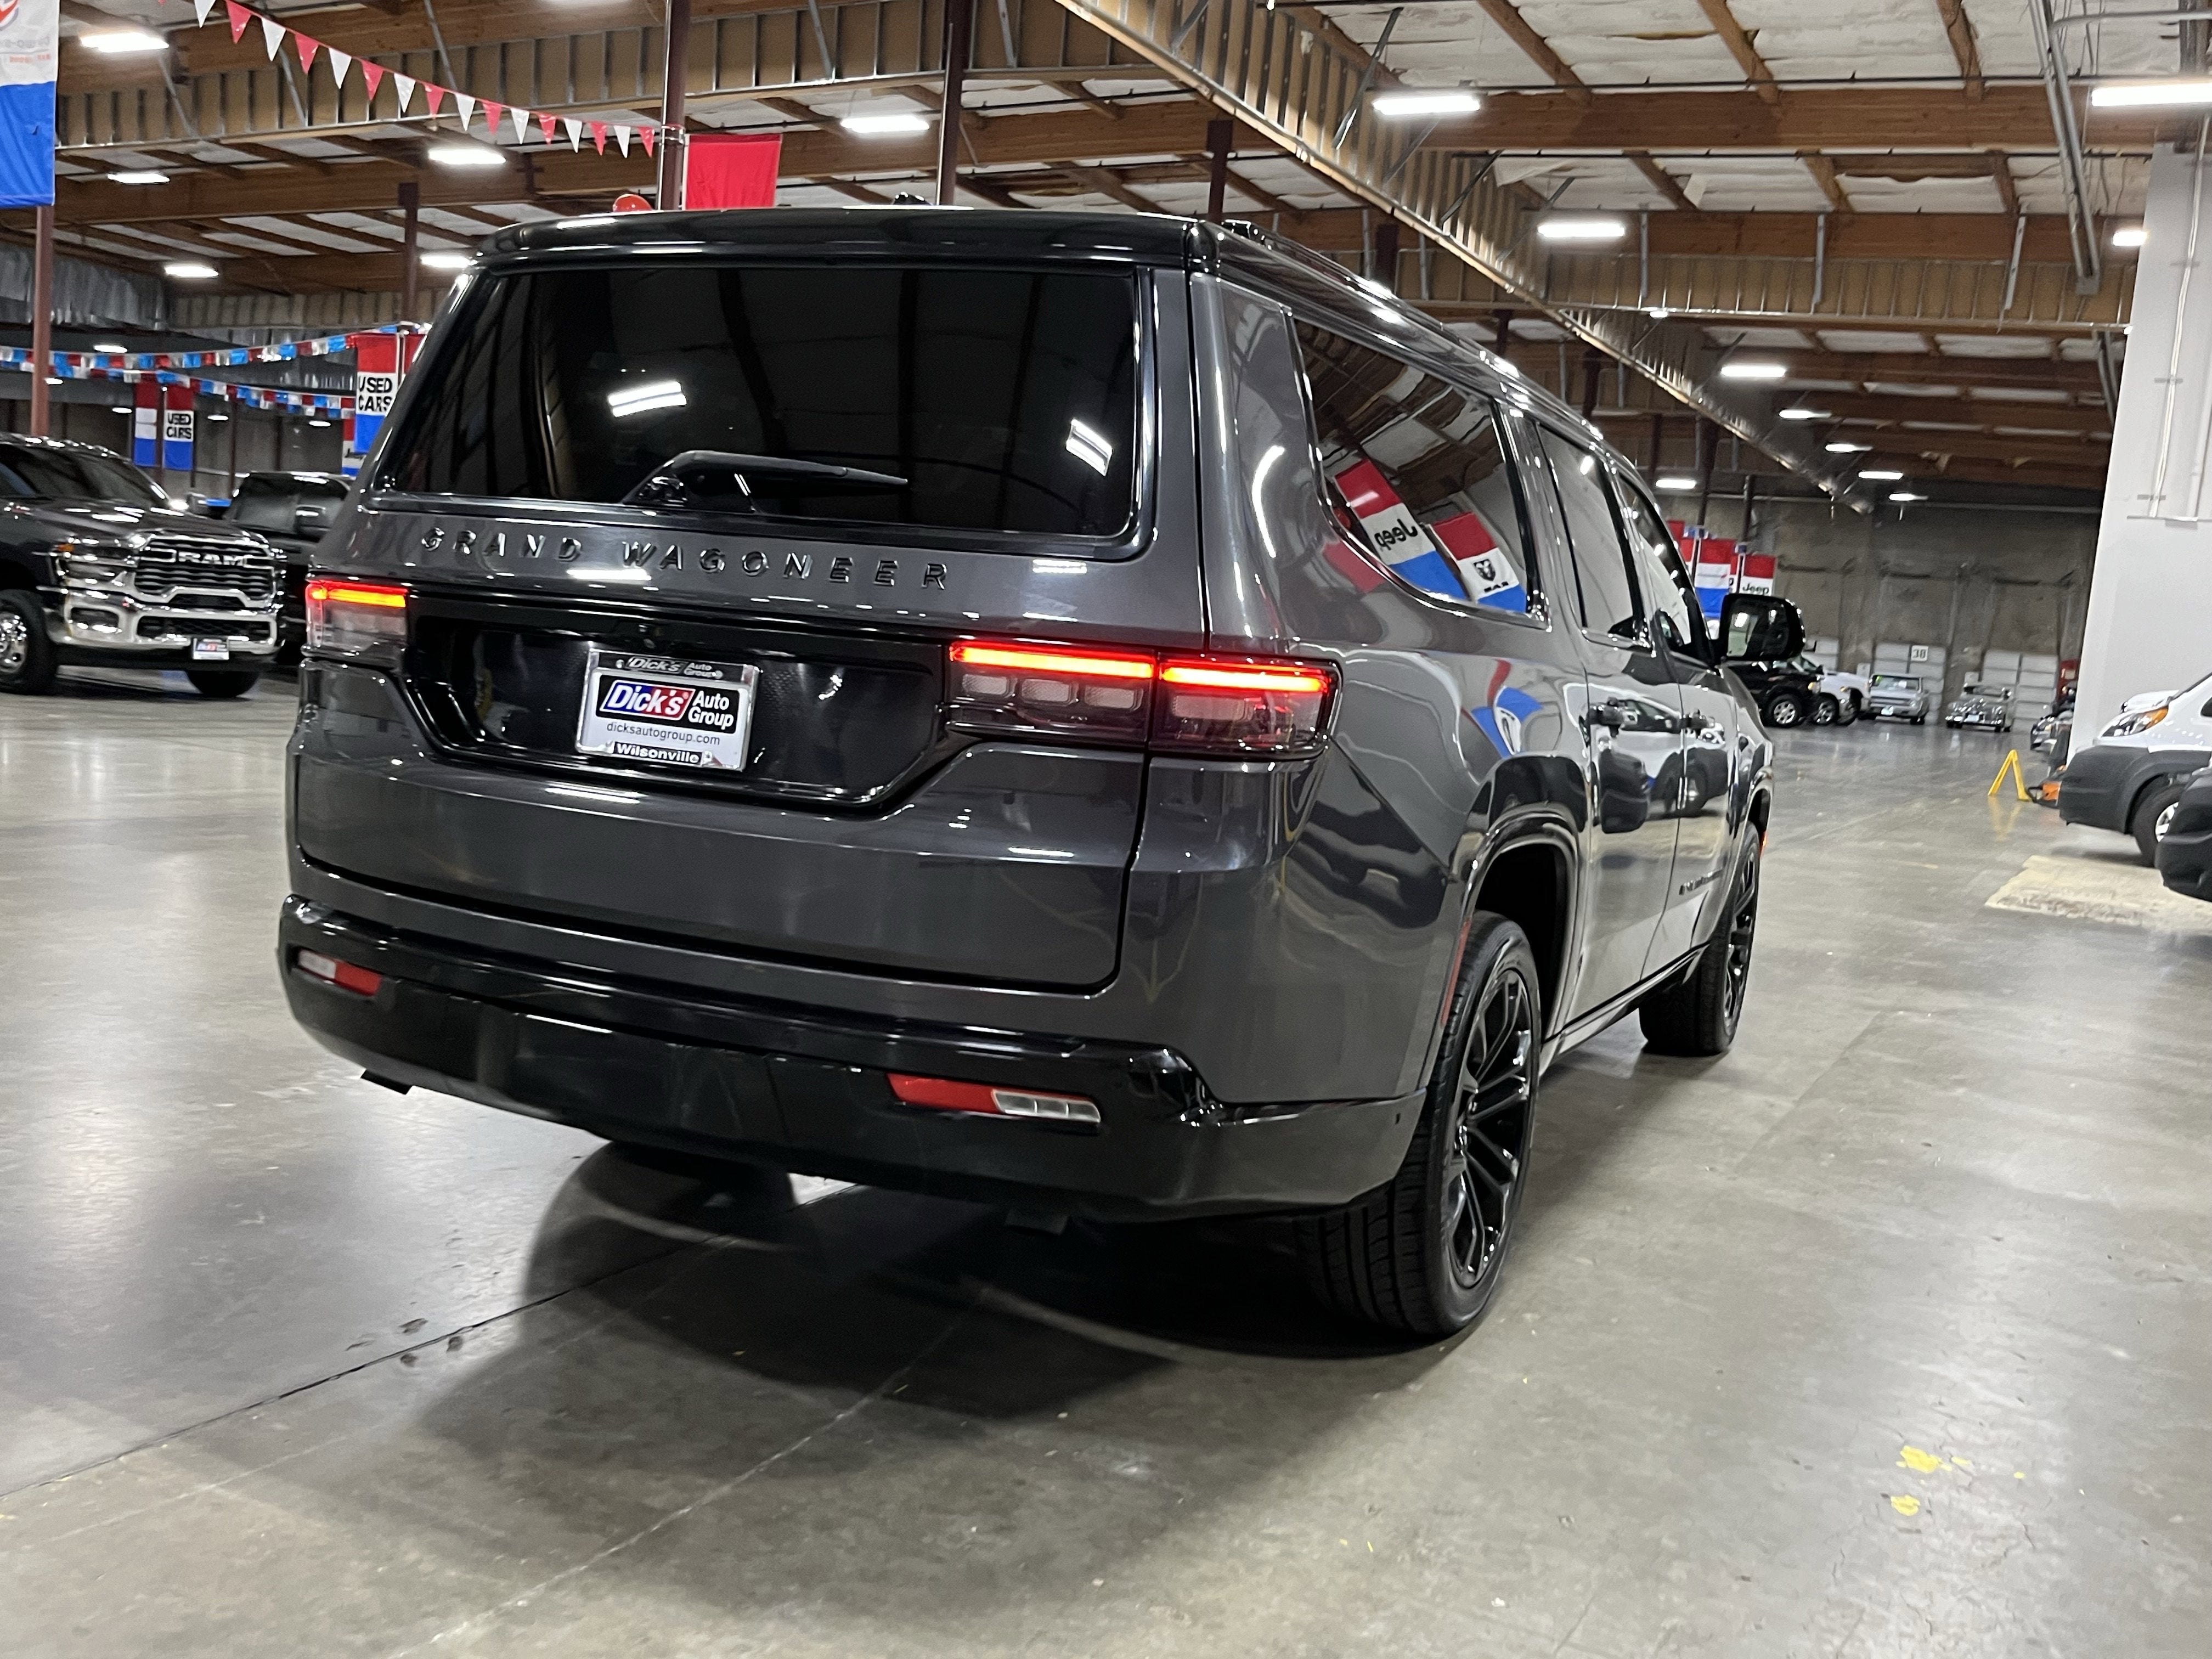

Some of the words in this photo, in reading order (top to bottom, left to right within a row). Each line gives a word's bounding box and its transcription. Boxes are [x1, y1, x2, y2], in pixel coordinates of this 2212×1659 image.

[358, 375, 393, 393] USED
[358, 394, 392, 412] CARS
[178, 551, 245, 567] RAM
[421, 527, 582, 563] GRAND
[621, 540, 949, 591] WAGONEER
[1742, 583, 1769, 596] Jeep
[630, 658, 680, 672] Dick's
[686, 662, 713, 671] Auto
[607, 685, 684, 715] Dick's
[692, 690, 730, 710] Auto
[687, 706, 735, 731] Group
[606, 721, 720, 746] dicksautogroup.com
[616, 743, 700, 764] Wilsonville
